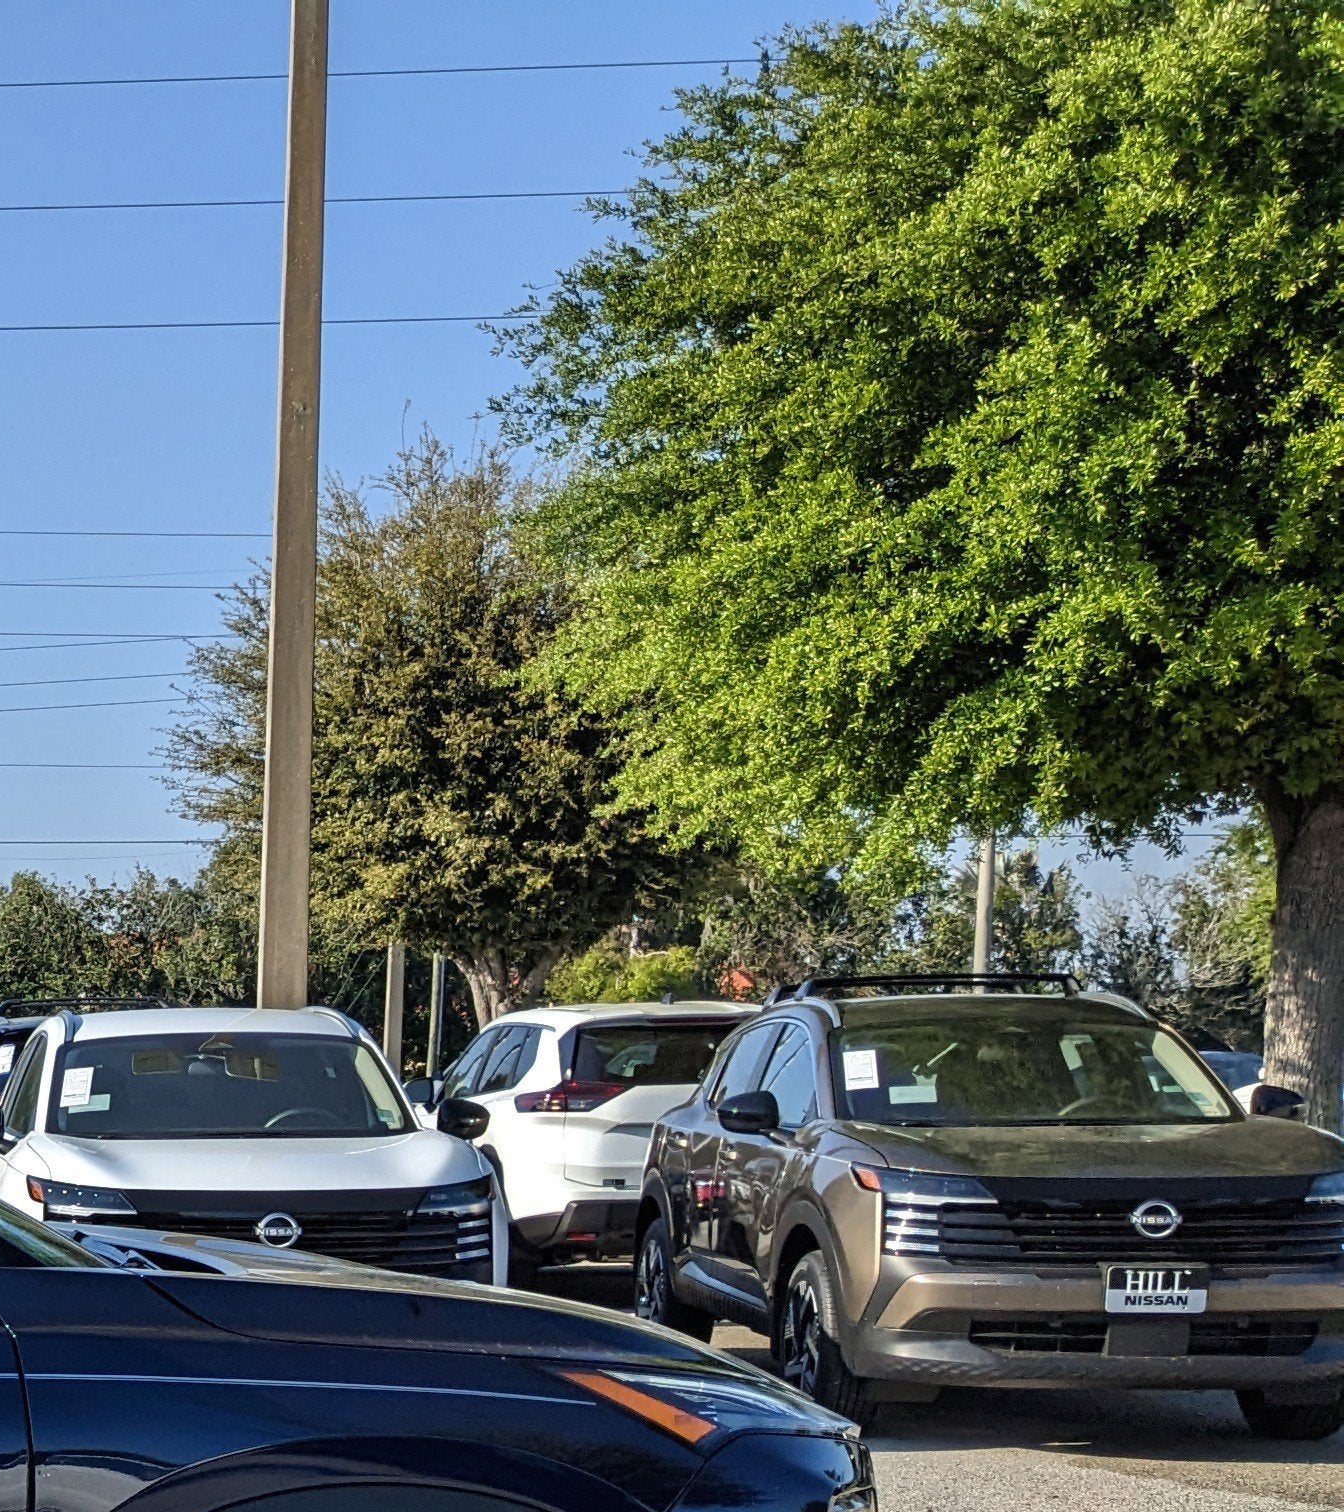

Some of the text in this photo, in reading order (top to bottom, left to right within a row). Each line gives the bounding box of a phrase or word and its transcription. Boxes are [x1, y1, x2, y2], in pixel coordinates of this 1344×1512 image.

[1130, 1215, 1182, 1225] NISSAN
[255, 1227, 302, 1236] NISSAN
[1125, 1270, 1189, 1294] HILL
[1125, 1295, 1188, 1306] NISSAN
